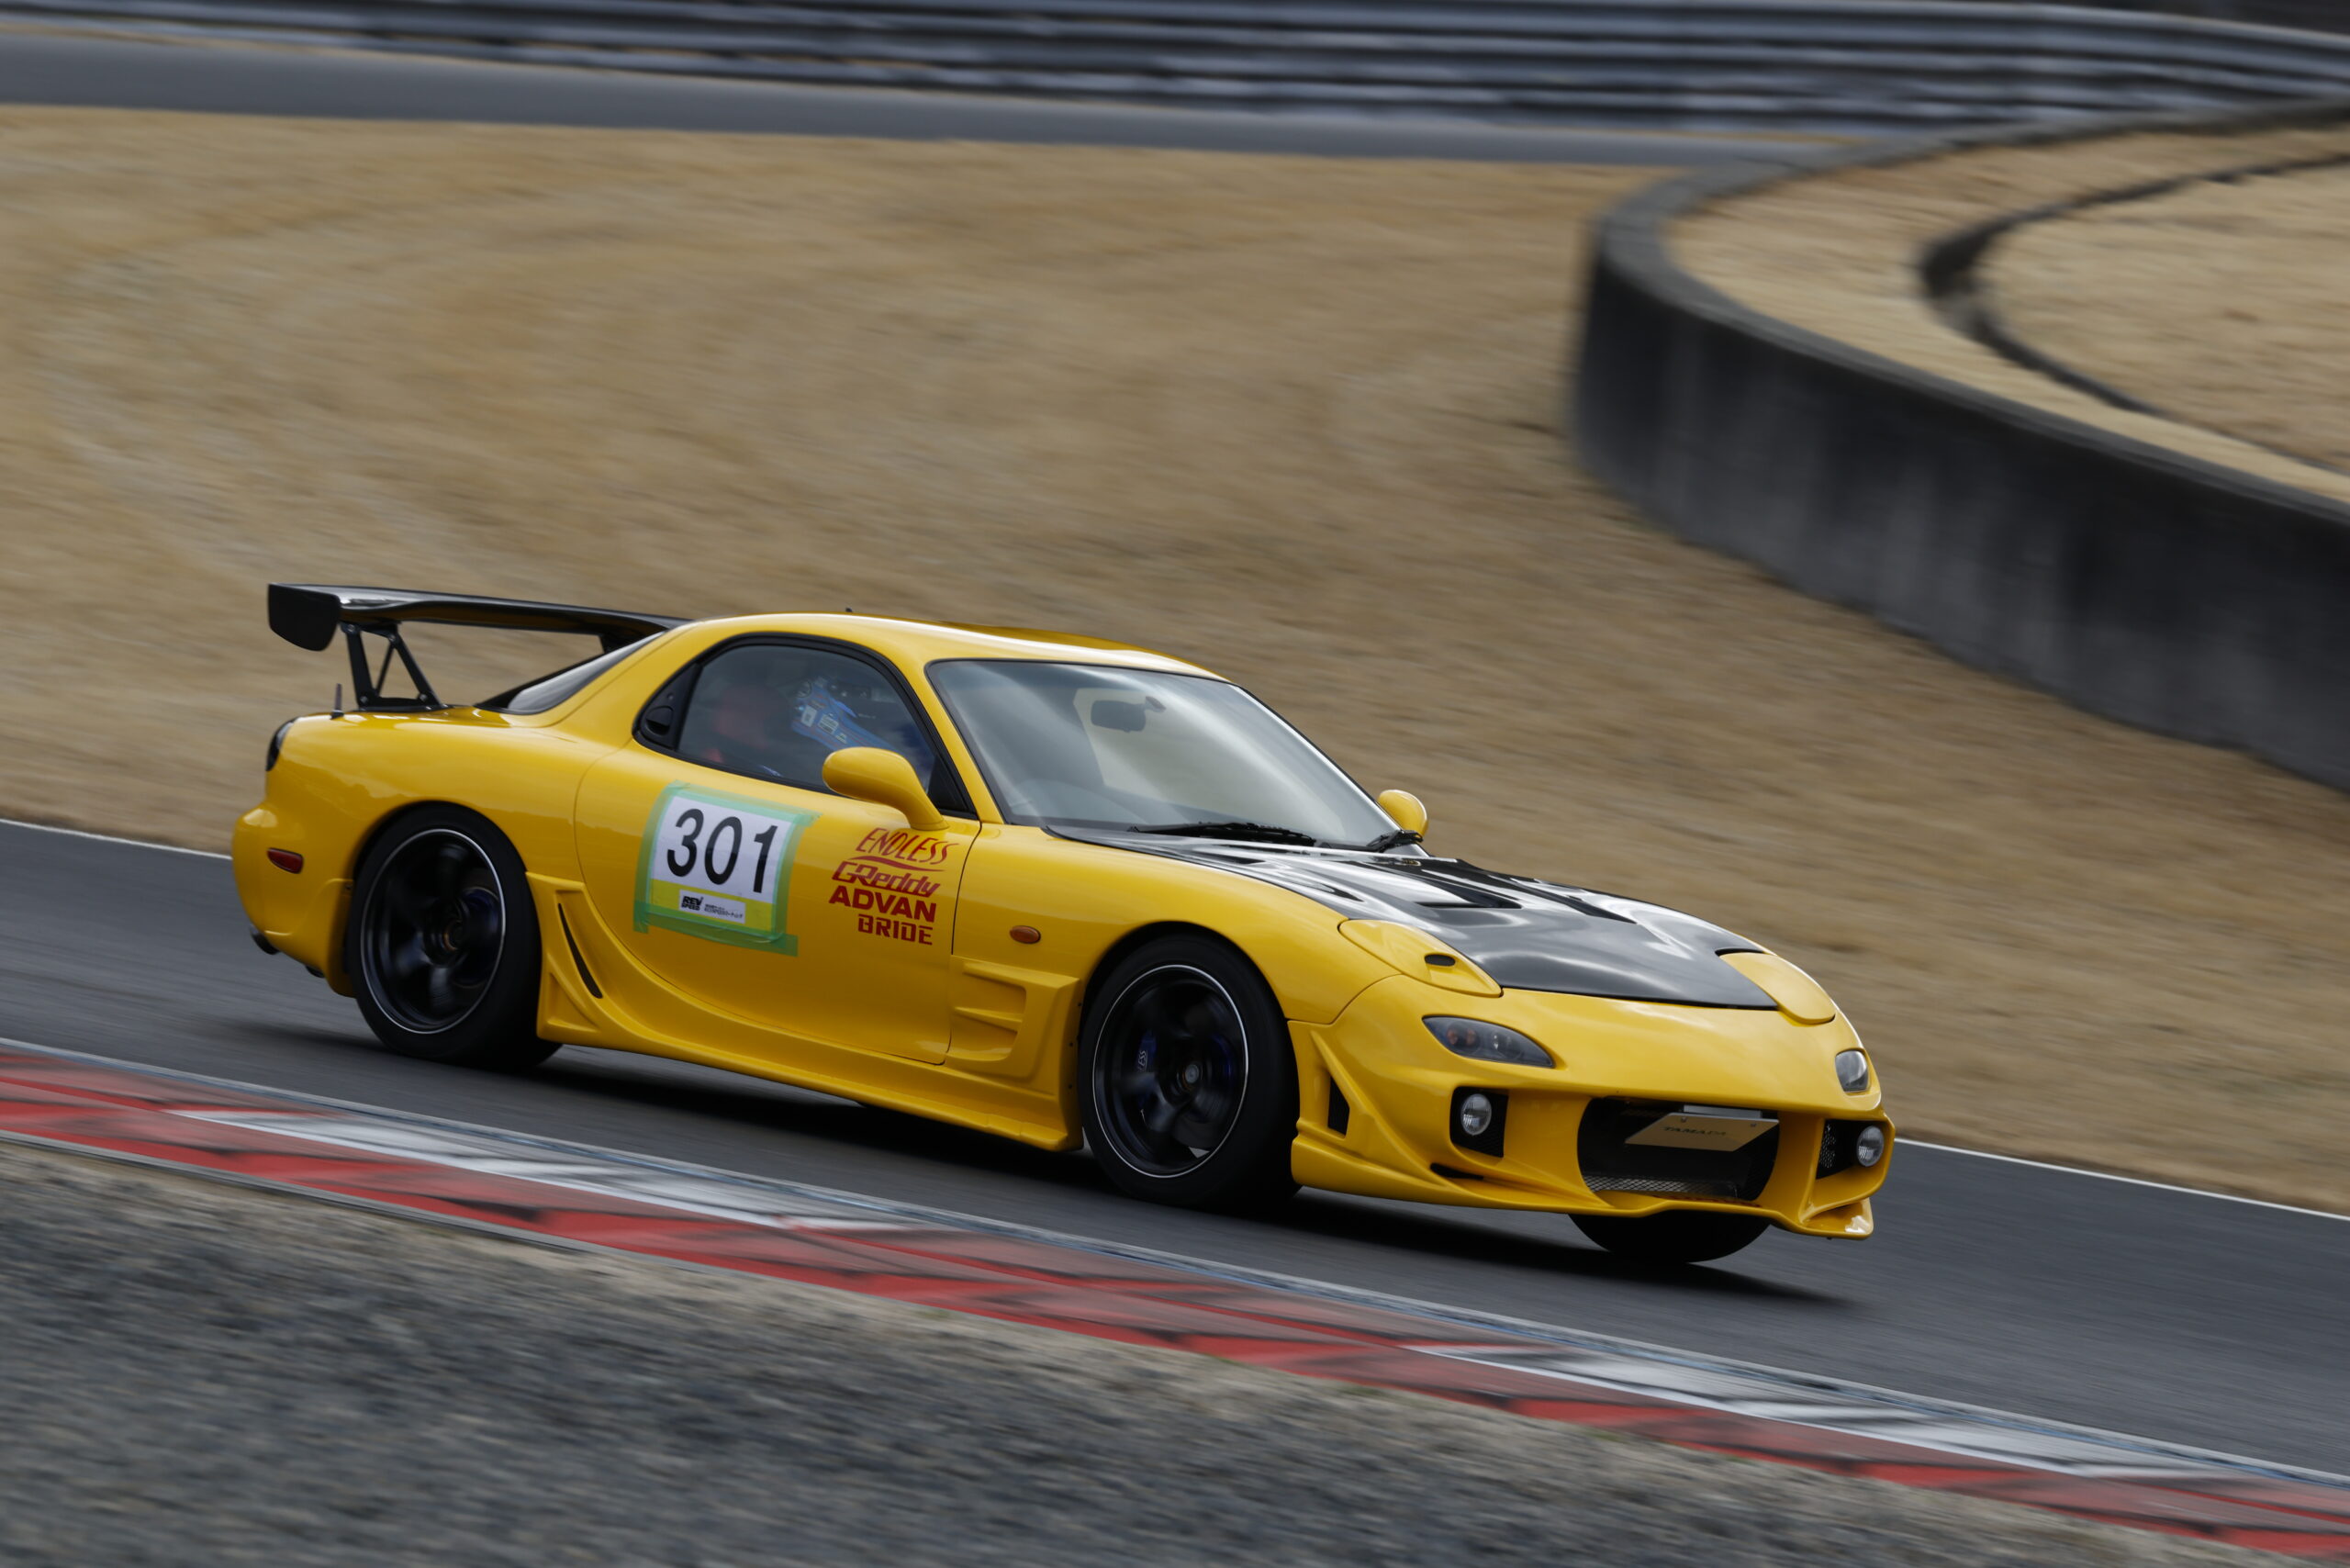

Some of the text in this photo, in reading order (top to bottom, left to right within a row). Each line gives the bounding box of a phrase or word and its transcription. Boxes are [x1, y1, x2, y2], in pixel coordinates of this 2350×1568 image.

[666, 808, 778, 893] 301
[856, 827, 959, 865] ENDLESS
[832, 860, 941, 898] GReddy
[682, 895, 704, 906] REV
[829, 885, 936, 923] ADVAN
[857, 913, 933, 946] BRIDE
